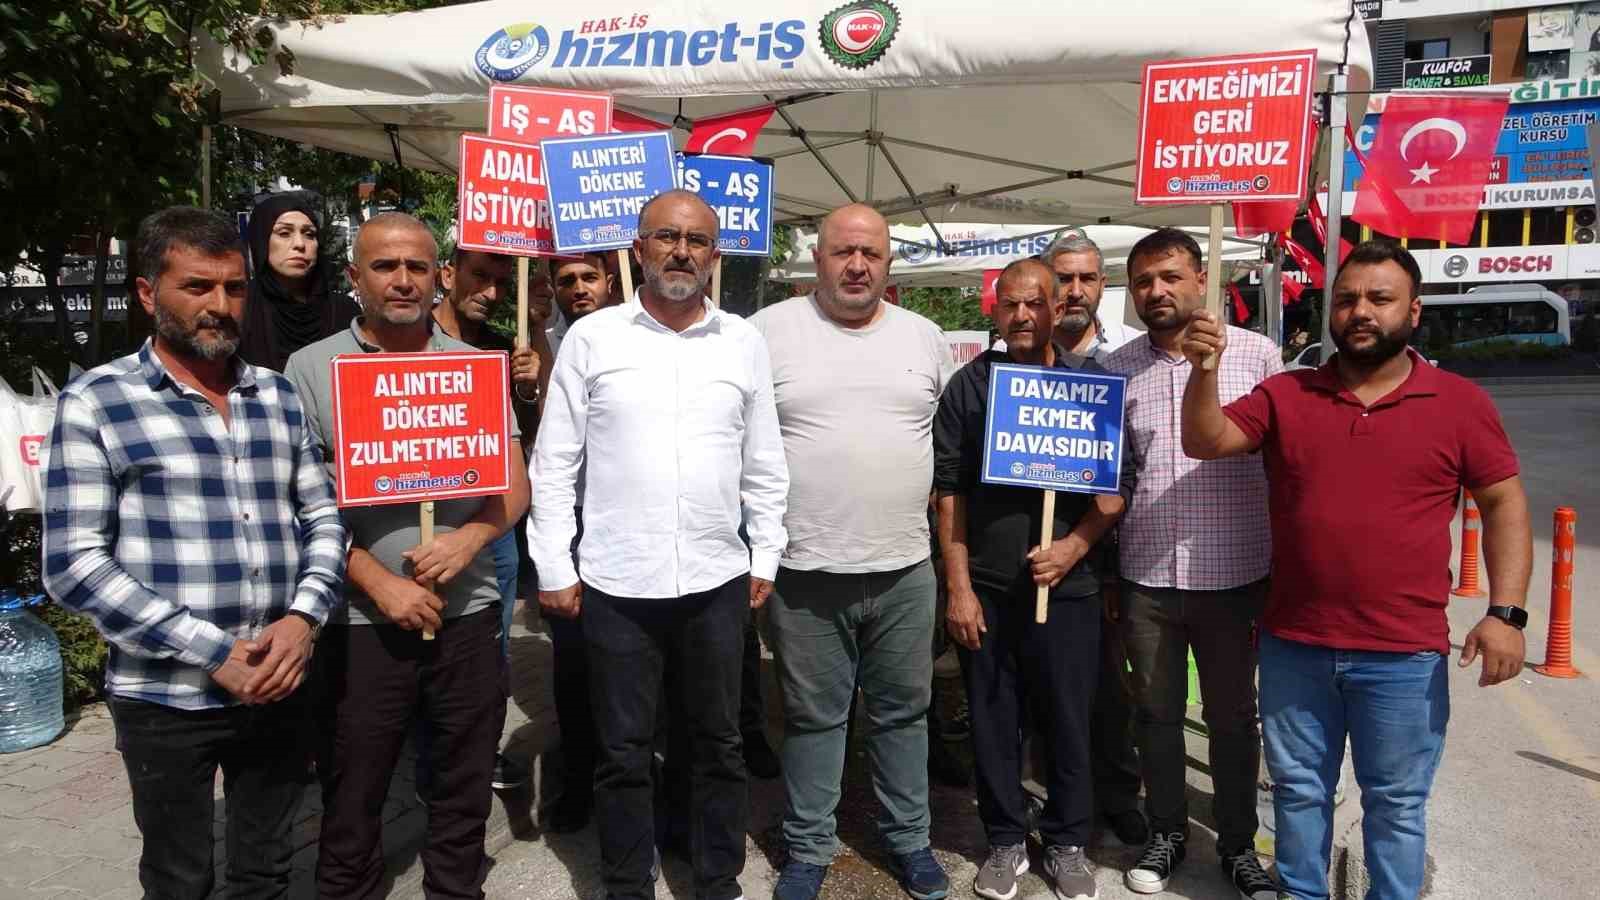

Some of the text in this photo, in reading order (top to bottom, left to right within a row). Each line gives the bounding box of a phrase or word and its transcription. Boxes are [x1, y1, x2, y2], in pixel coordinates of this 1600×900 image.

[579, 14, 649, 34] HAK-İŞ
[1153, 64, 1303, 104] EKMEĞİMİZİ
[1514, 79, 1600, 101] ĞİTİ
[502, 96, 529, 135] İŞ
[1193, 102, 1253, 134] GERİ
[1503, 110, 1596, 129] ZEL ÖĞRETİM
[1520, 130, 1567, 143] KURSU
[480, 148, 545, 186] ADAL
[571, 141, 646, 169] ALINTERİ
[1154, 138, 1290, 168] İSTİYORUZ
[579, 169, 645, 194] DÖKENE
[725, 172, 760, 202] AŞ
[1495, 187, 1594, 203] KURUMSA
[465, 181, 553, 229] İSTİYOR
[558, 190, 660, 221] ZULMETME
[710, 205, 760, 232] MEK
[1478, 255, 1553, 274] BOSCH
[374, 364, 473, 397] ALINTERİ
[1010, 377, 1109, 405] DAVAMIZ
[382, 399, 468, 430] DÖKENE
[1018, 405, 1096, 431] EKMEK
[350, 428, 499, 466] ZULMETMEYİN
[996, 431, 1114, 461] DAVASIDIR
